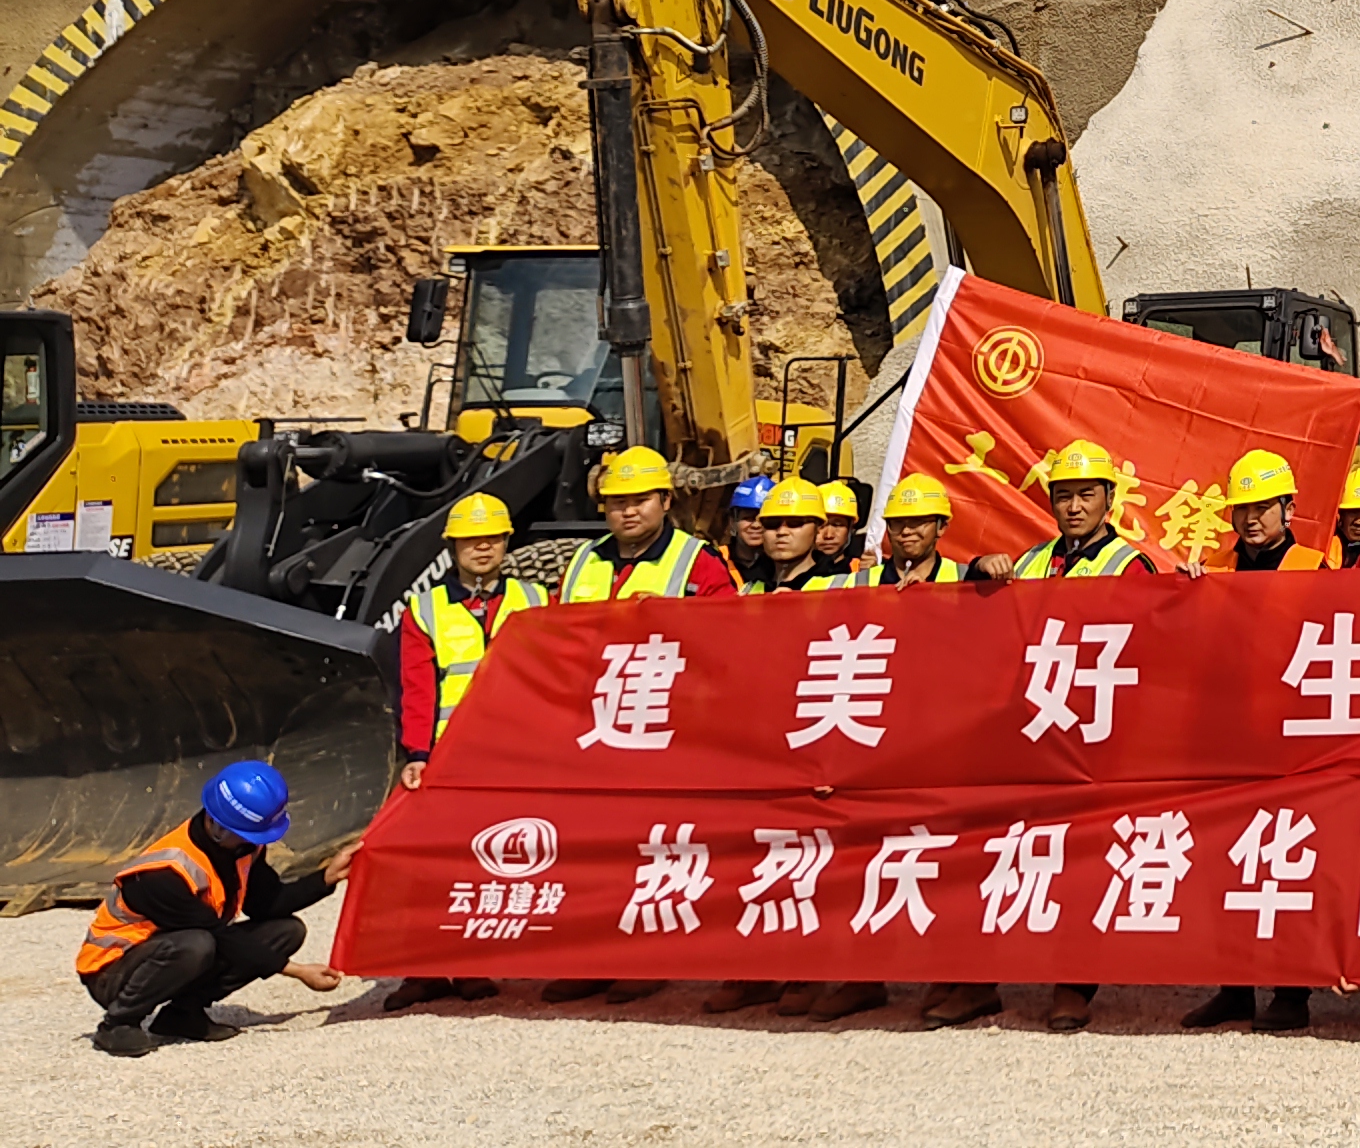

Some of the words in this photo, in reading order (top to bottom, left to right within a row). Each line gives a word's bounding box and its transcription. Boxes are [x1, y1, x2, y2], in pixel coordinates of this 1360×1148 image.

[448, 880, 566, 915] 云南建投
[463, 918, 528, 939] YCIH
